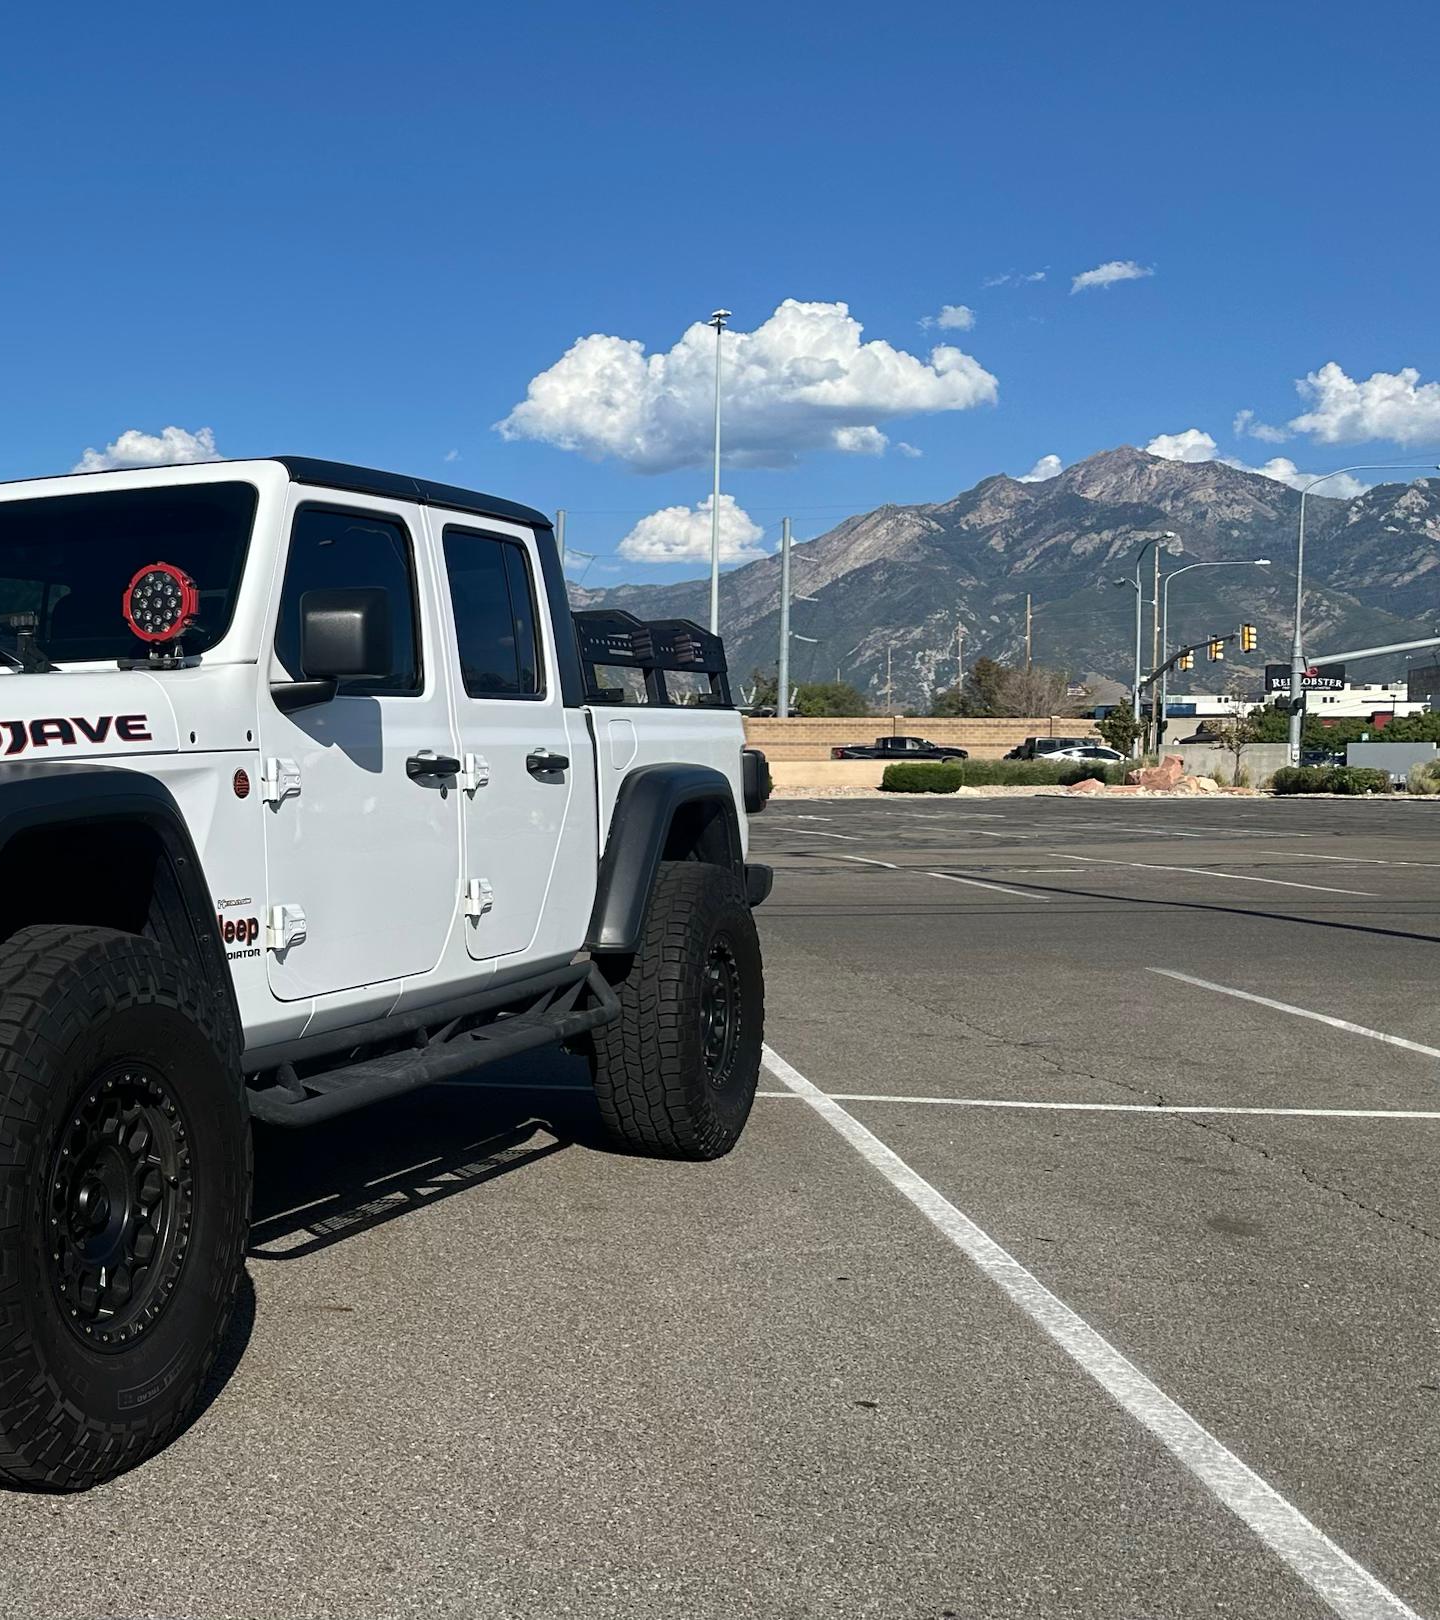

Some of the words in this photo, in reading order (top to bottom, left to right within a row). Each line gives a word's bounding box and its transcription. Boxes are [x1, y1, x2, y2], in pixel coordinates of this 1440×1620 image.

[1272, 678, 1291, 688] RE
[1300, 677, 1343, 688] OBSTER
[226, 948, 261, 960] DIATOR
